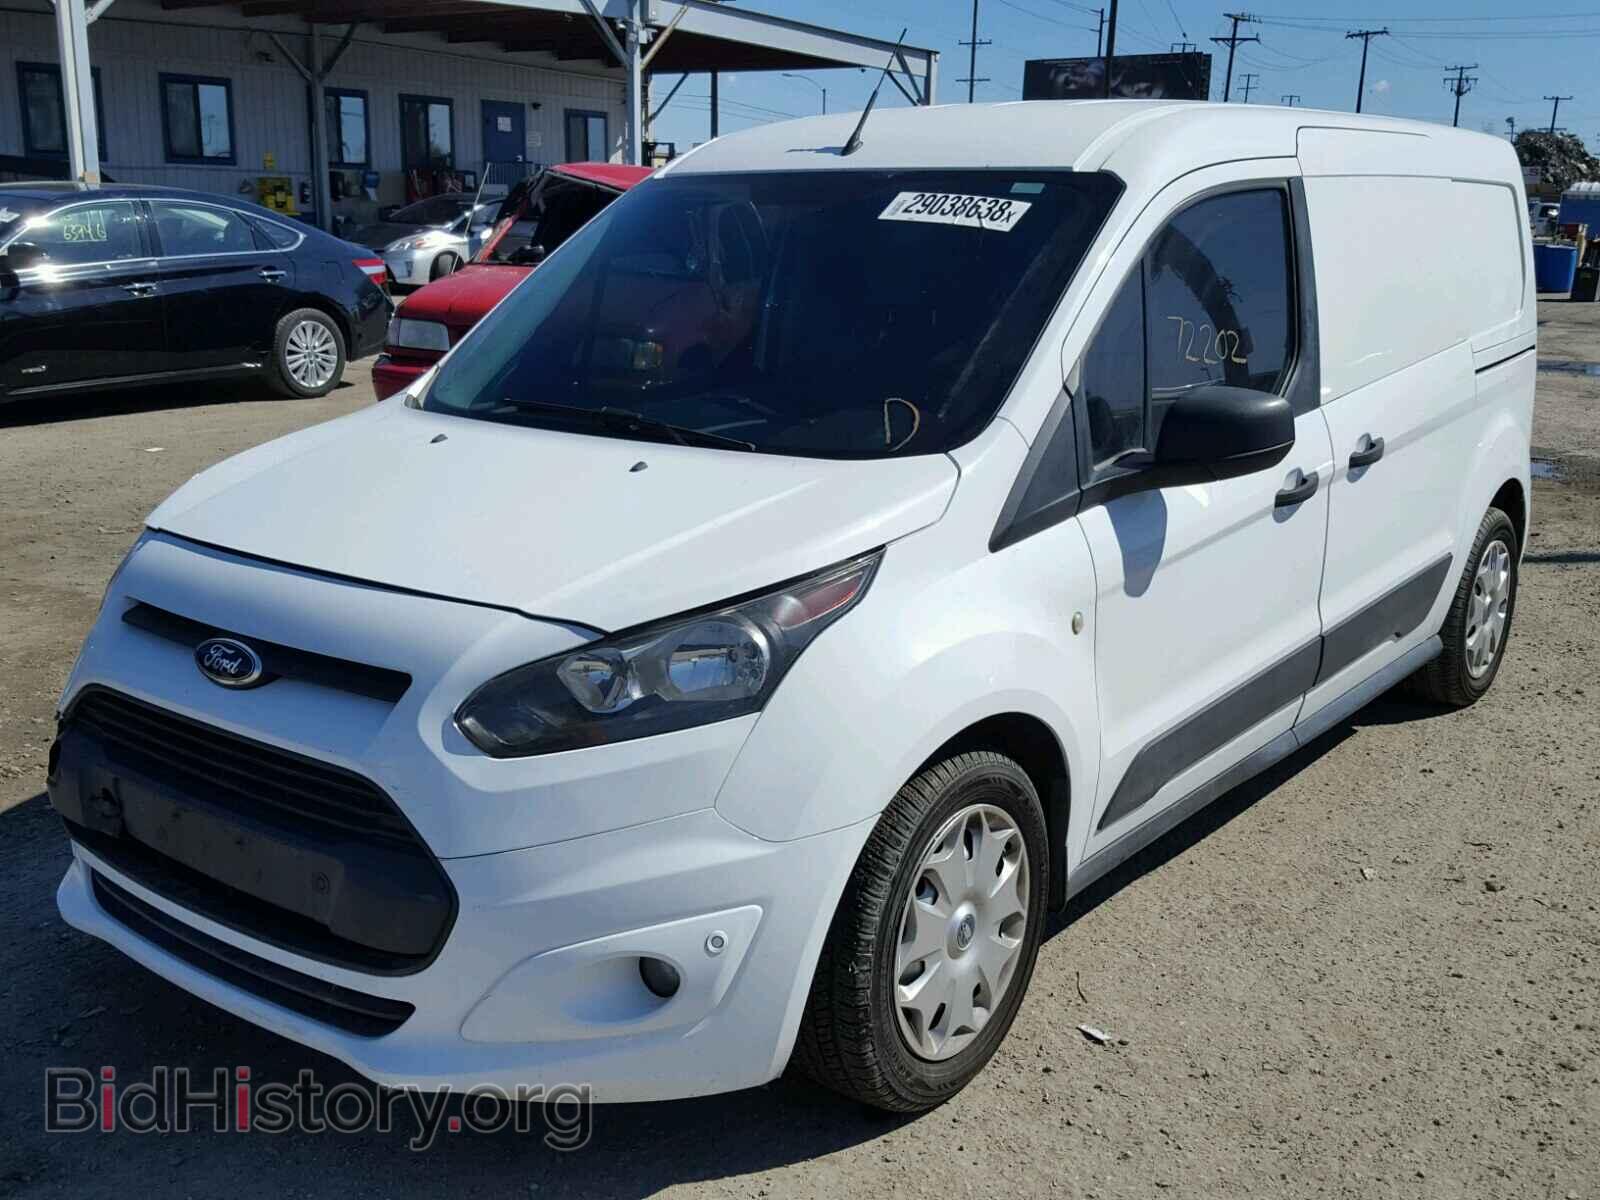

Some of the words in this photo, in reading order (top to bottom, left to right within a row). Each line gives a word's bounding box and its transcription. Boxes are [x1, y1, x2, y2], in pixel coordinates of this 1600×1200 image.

[1167, 316, 1248, 363] 72202
[884, 397, 920, 452] D
[204, 644, 242, 674] Ford
